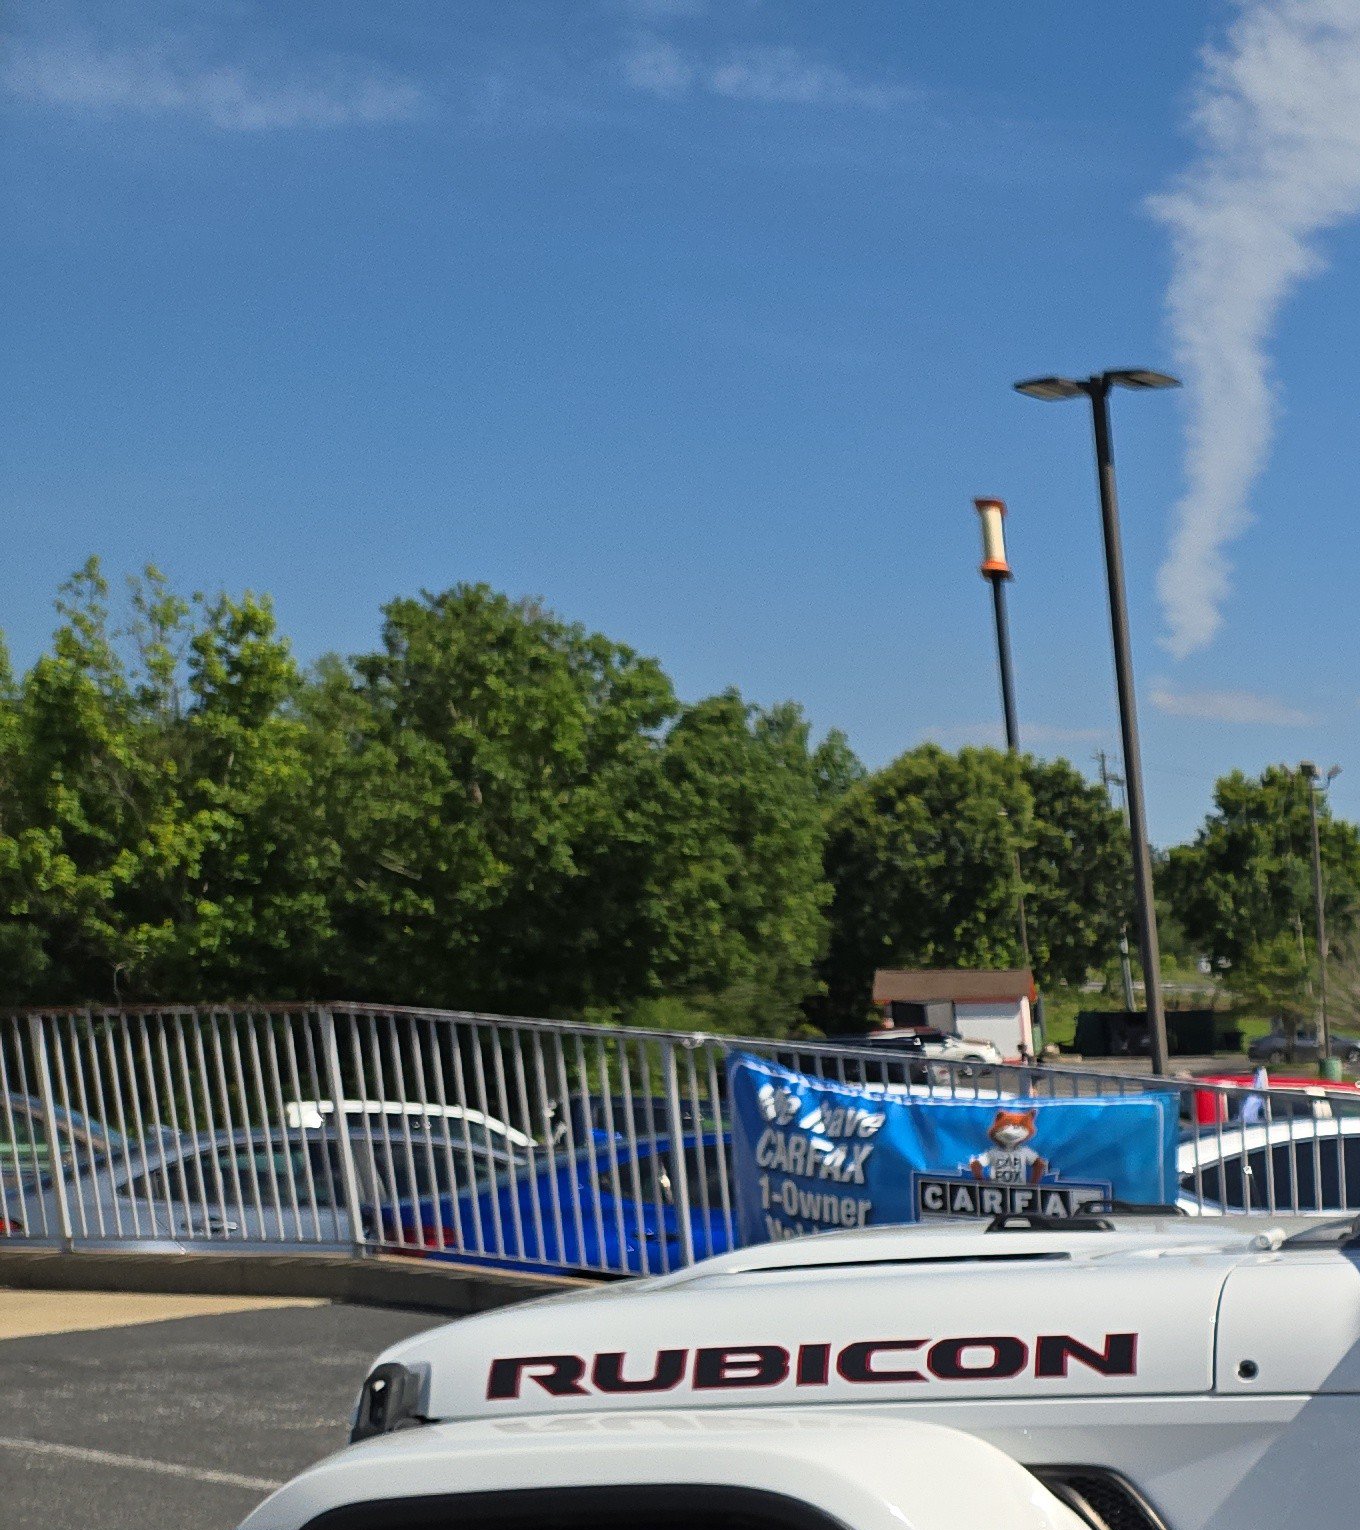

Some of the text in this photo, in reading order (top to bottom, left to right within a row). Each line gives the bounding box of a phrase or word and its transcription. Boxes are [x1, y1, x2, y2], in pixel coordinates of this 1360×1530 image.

[756, 1128, 874, 1185] CARFAX
[995, 1169, 1022, 1184] FOX
[758, 1173, 872, 1228] 1-Owner
[923, 1183, 1098, 1219] CARFA
[485, 1332, 1138, 1401] RUBICON
